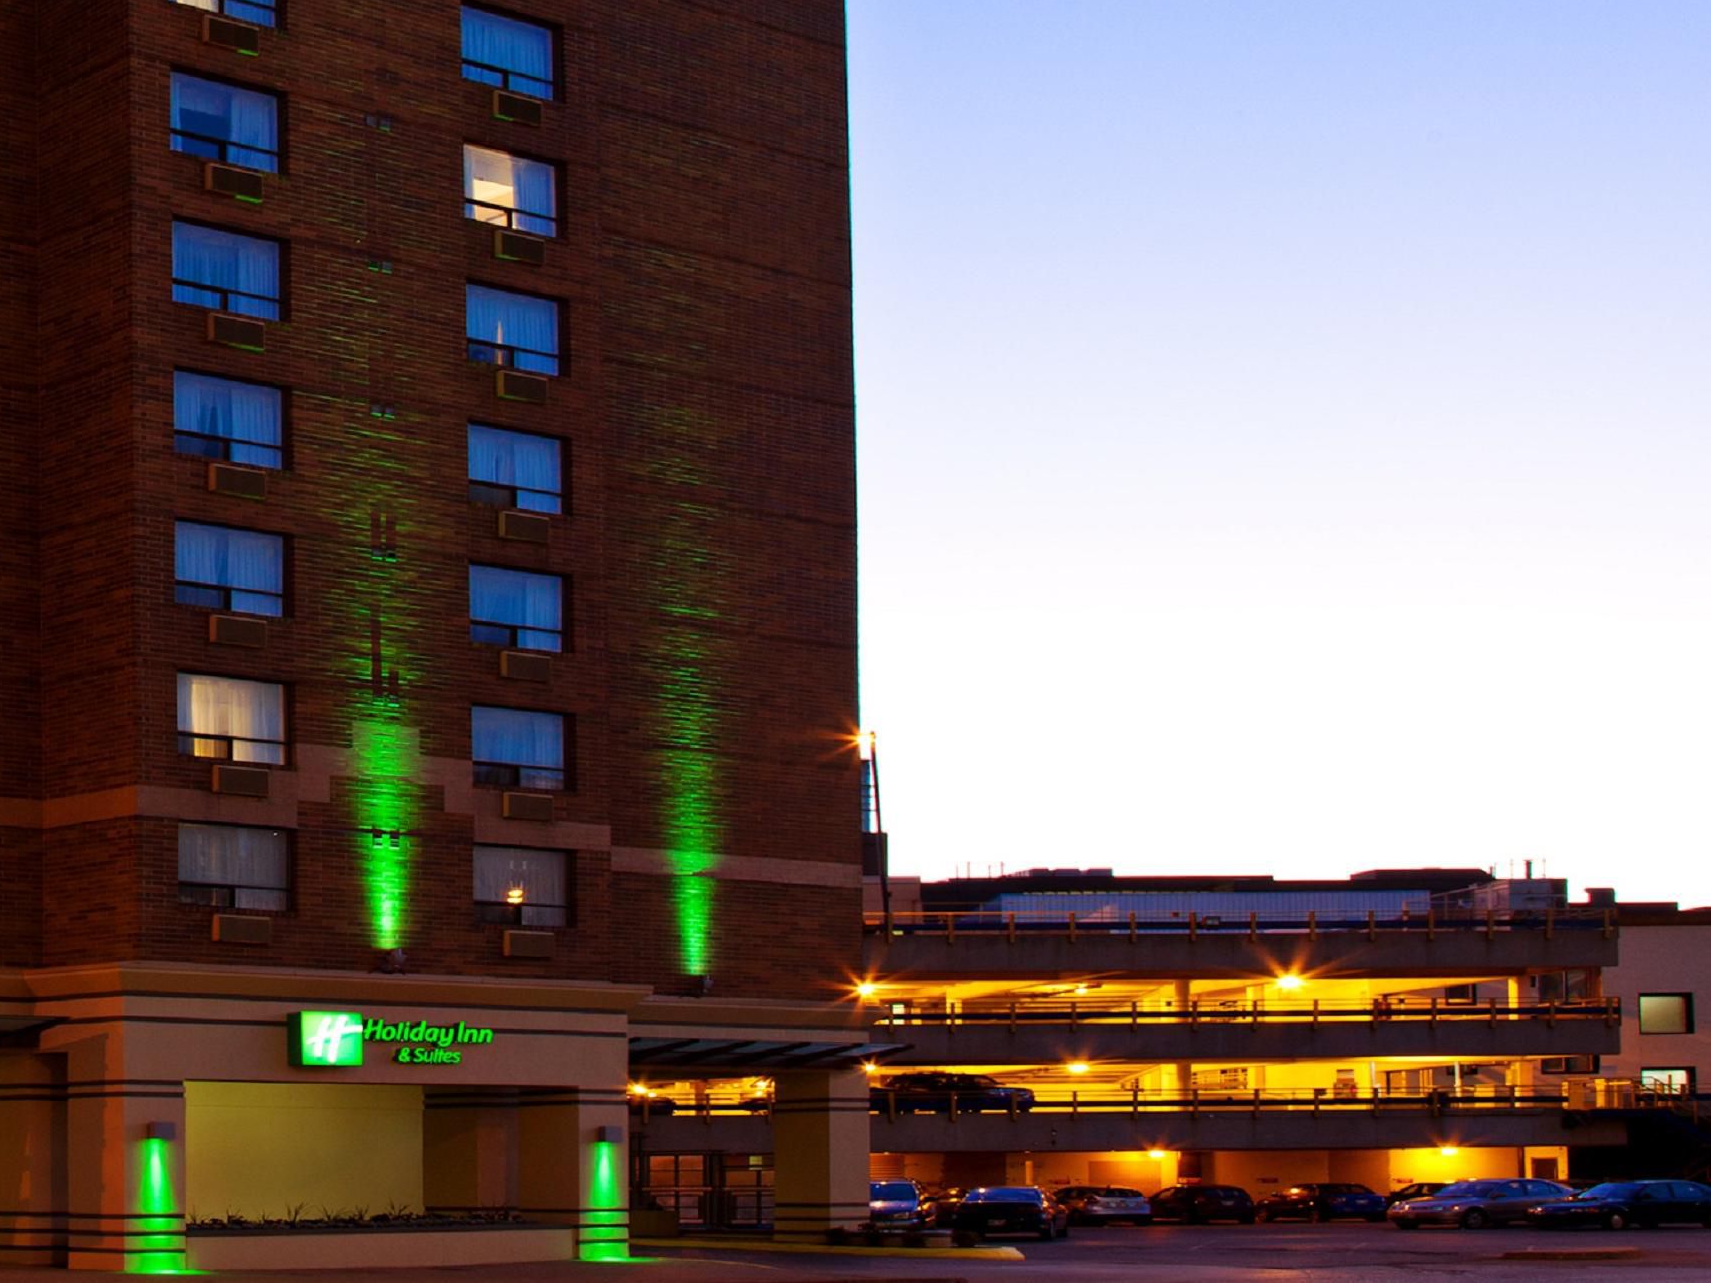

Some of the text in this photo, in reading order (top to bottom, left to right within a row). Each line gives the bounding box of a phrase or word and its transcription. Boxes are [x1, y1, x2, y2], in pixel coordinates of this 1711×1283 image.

[364, 1019, 494, 1047] Holiday Inn
[398, 1047, 461, 1063] & Suites
